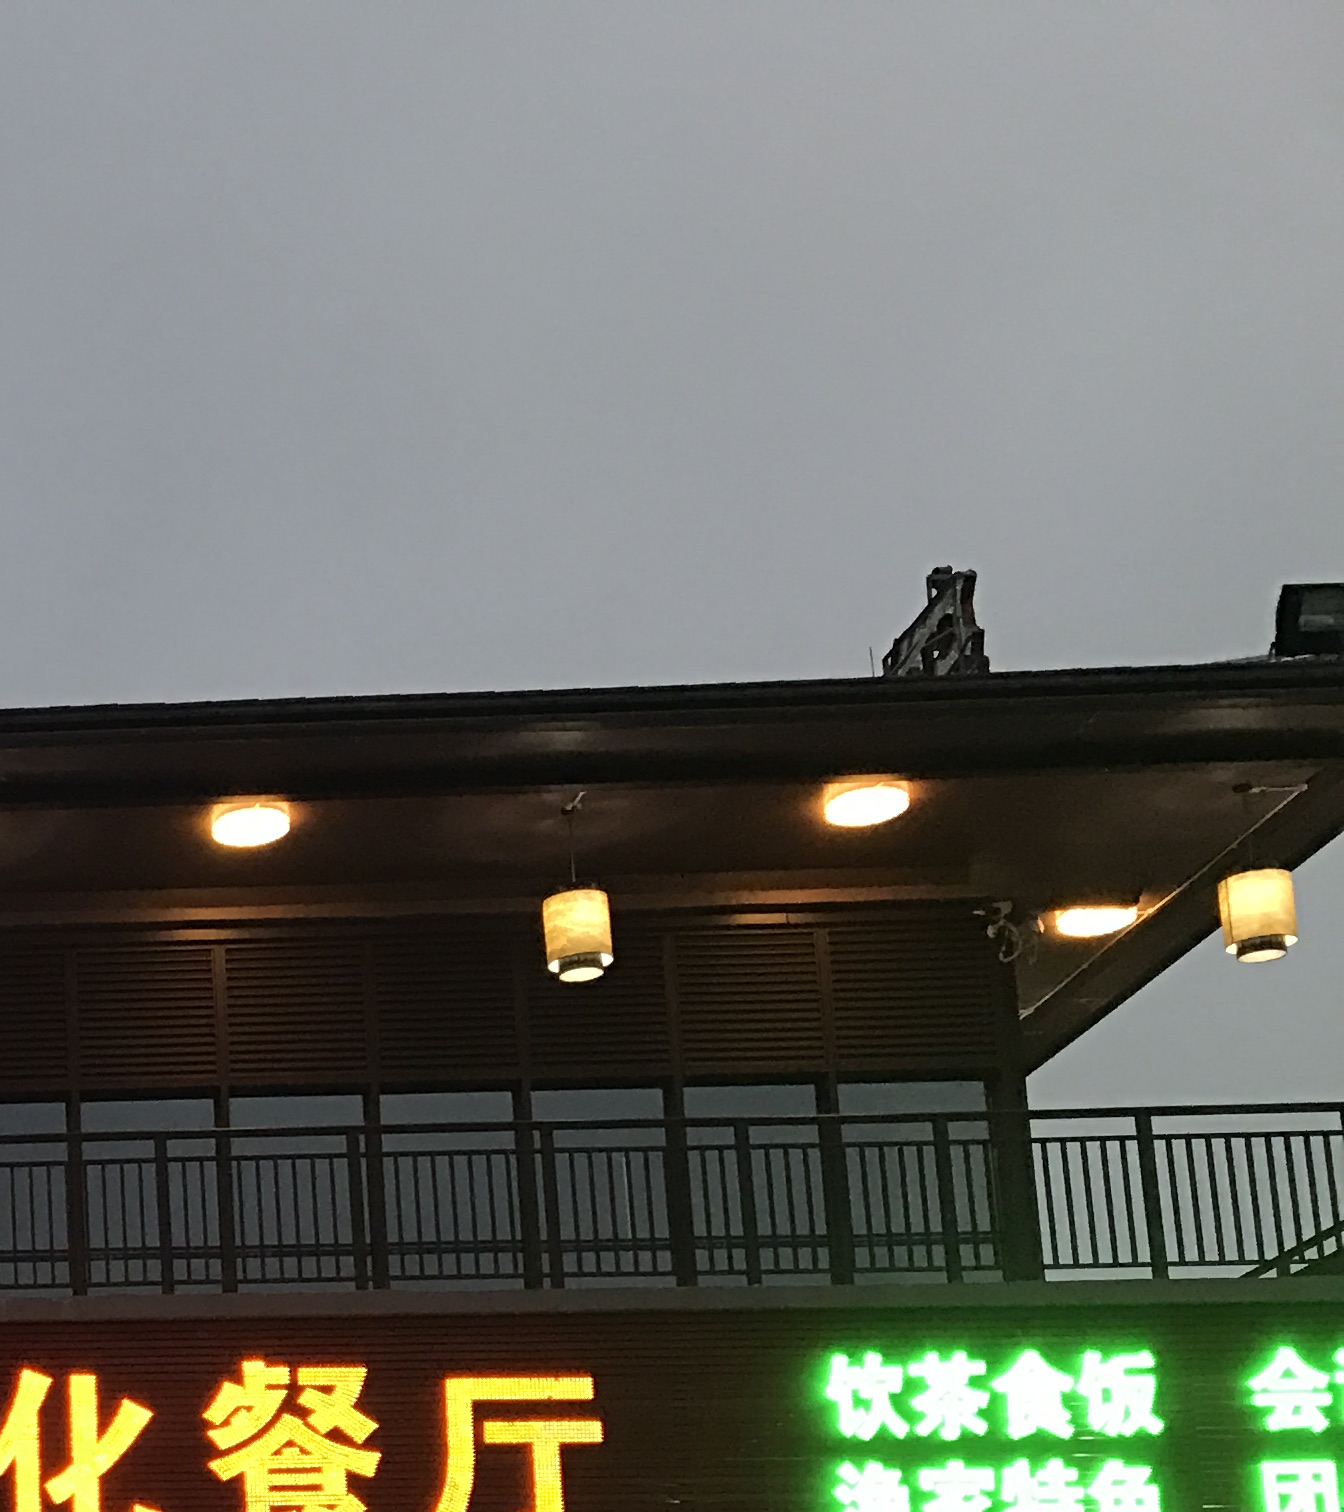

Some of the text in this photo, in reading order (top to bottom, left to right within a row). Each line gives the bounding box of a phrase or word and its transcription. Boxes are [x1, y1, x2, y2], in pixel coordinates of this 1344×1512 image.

[820, 1347, 1166, 1442] 饮茶食饭
[1244, 1345, 1344, 1435] 会
